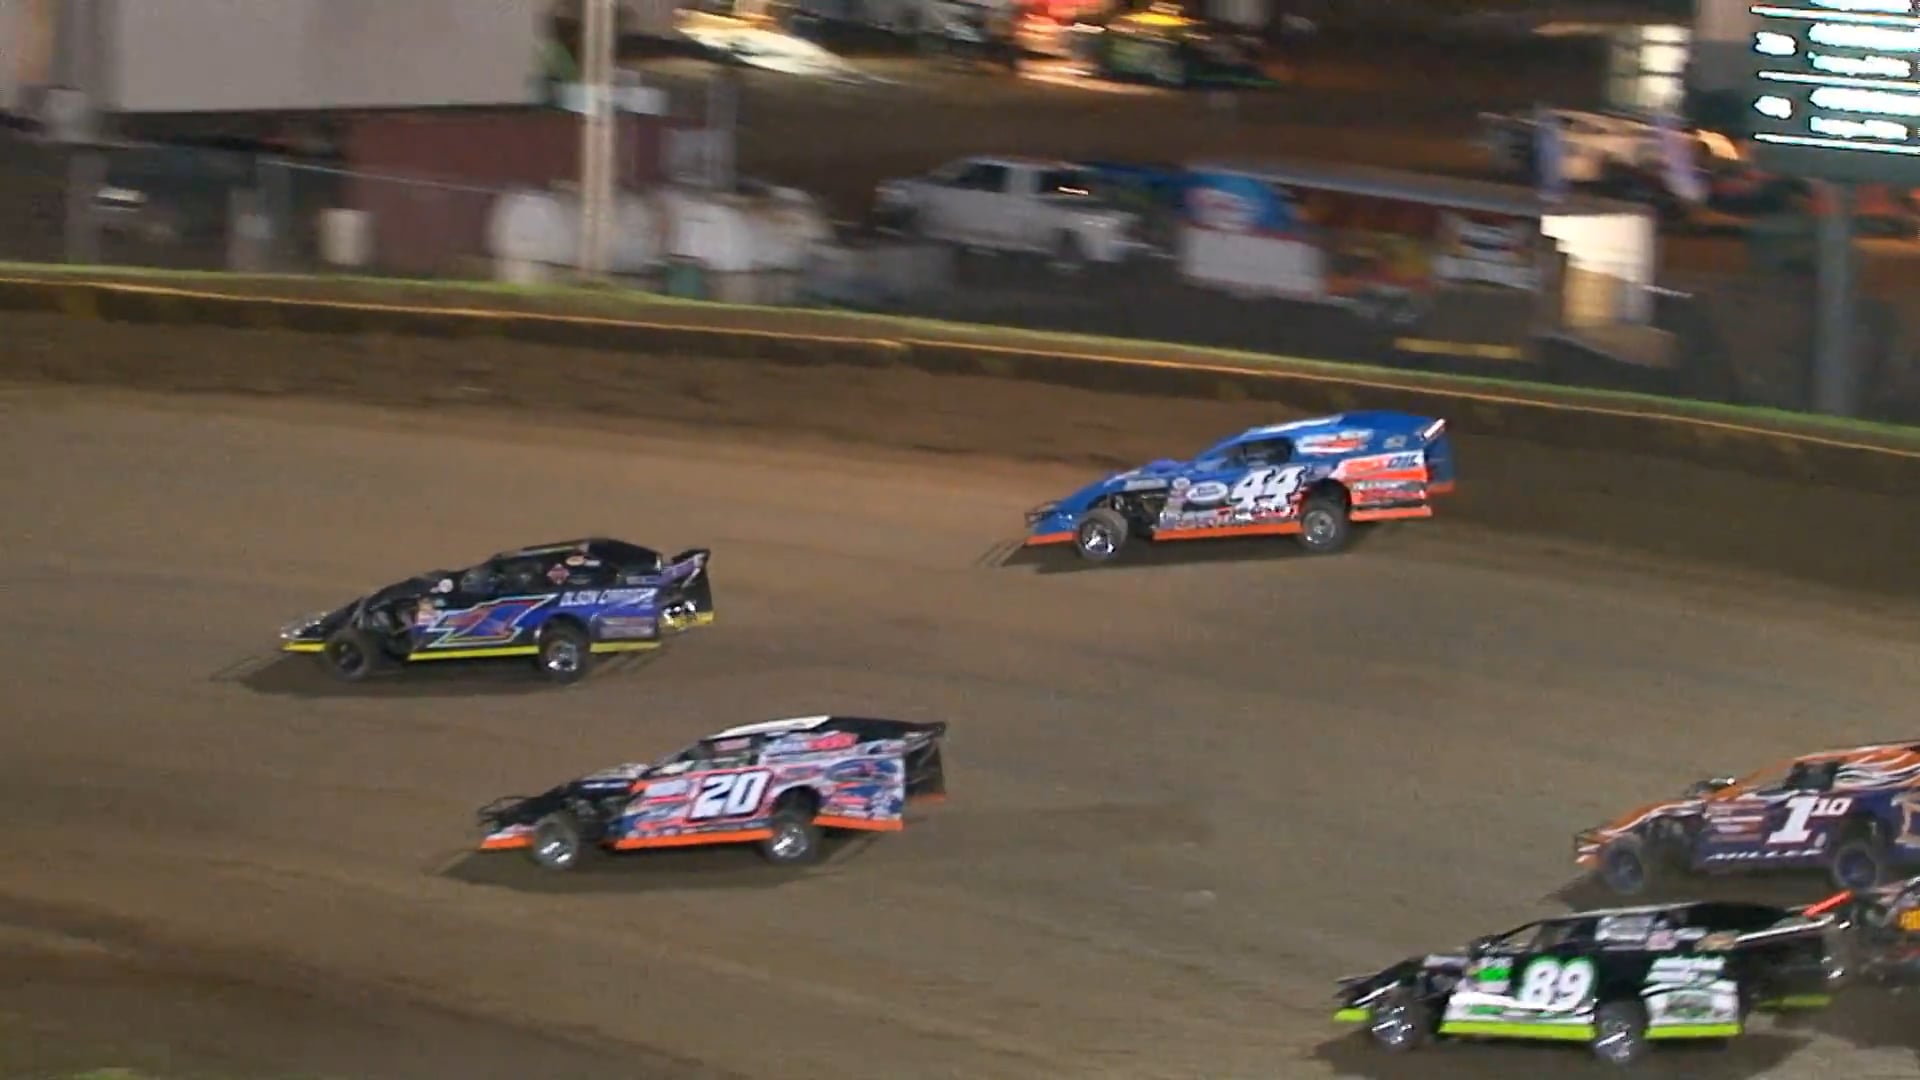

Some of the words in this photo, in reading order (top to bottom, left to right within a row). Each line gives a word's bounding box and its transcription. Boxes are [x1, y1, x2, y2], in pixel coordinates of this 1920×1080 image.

[1231, 466, 1305, 510] 44
[690, 770, 771, 818] 20
[1519, 957, 1595, 1010] 89
